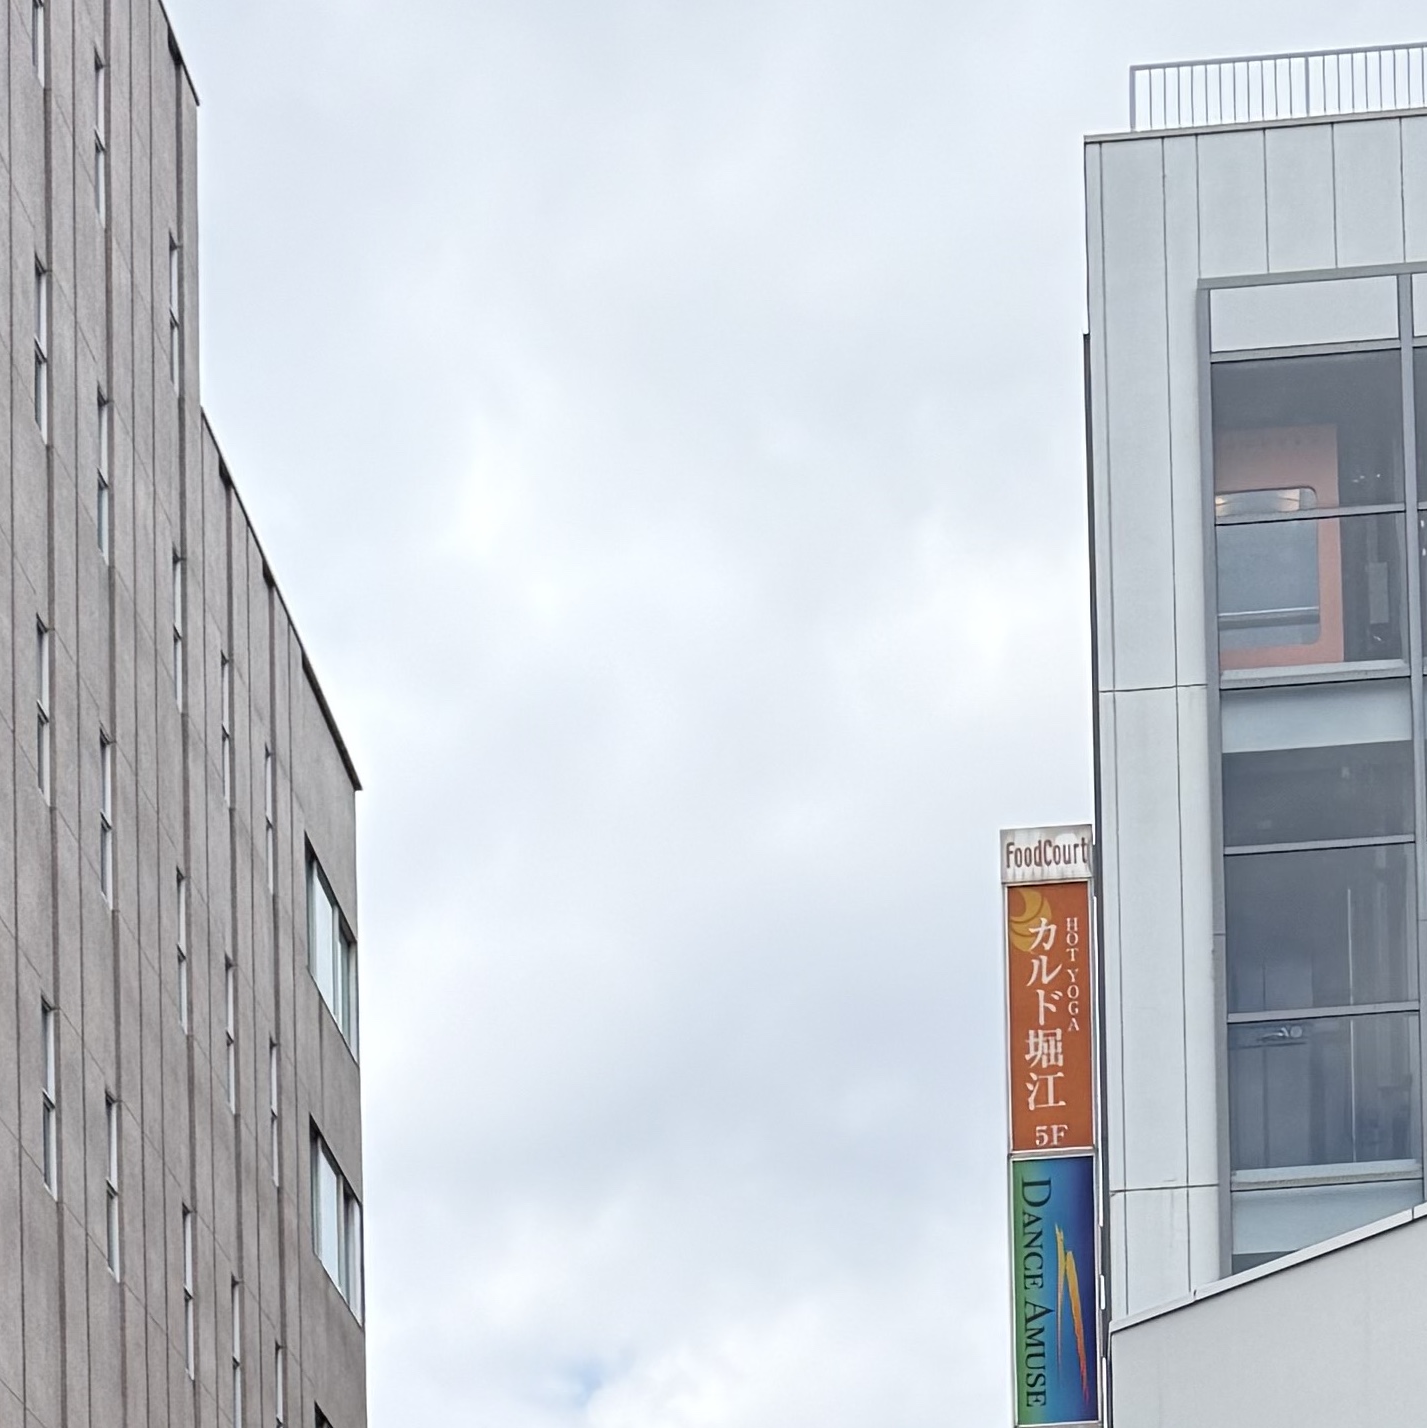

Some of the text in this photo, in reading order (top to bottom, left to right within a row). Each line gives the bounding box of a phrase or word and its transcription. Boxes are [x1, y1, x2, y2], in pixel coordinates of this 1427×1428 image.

[1006, 836, 1088, 869] FoodCourt
[1025, 917, 1066, 1111] カルド堀江
[1066, 917, 1080, 1032] HOT YOGA
[1035, 1125, 1068, 1147] 5F
[1021, 1177, 1055, 1408] DANCE AMUSE
